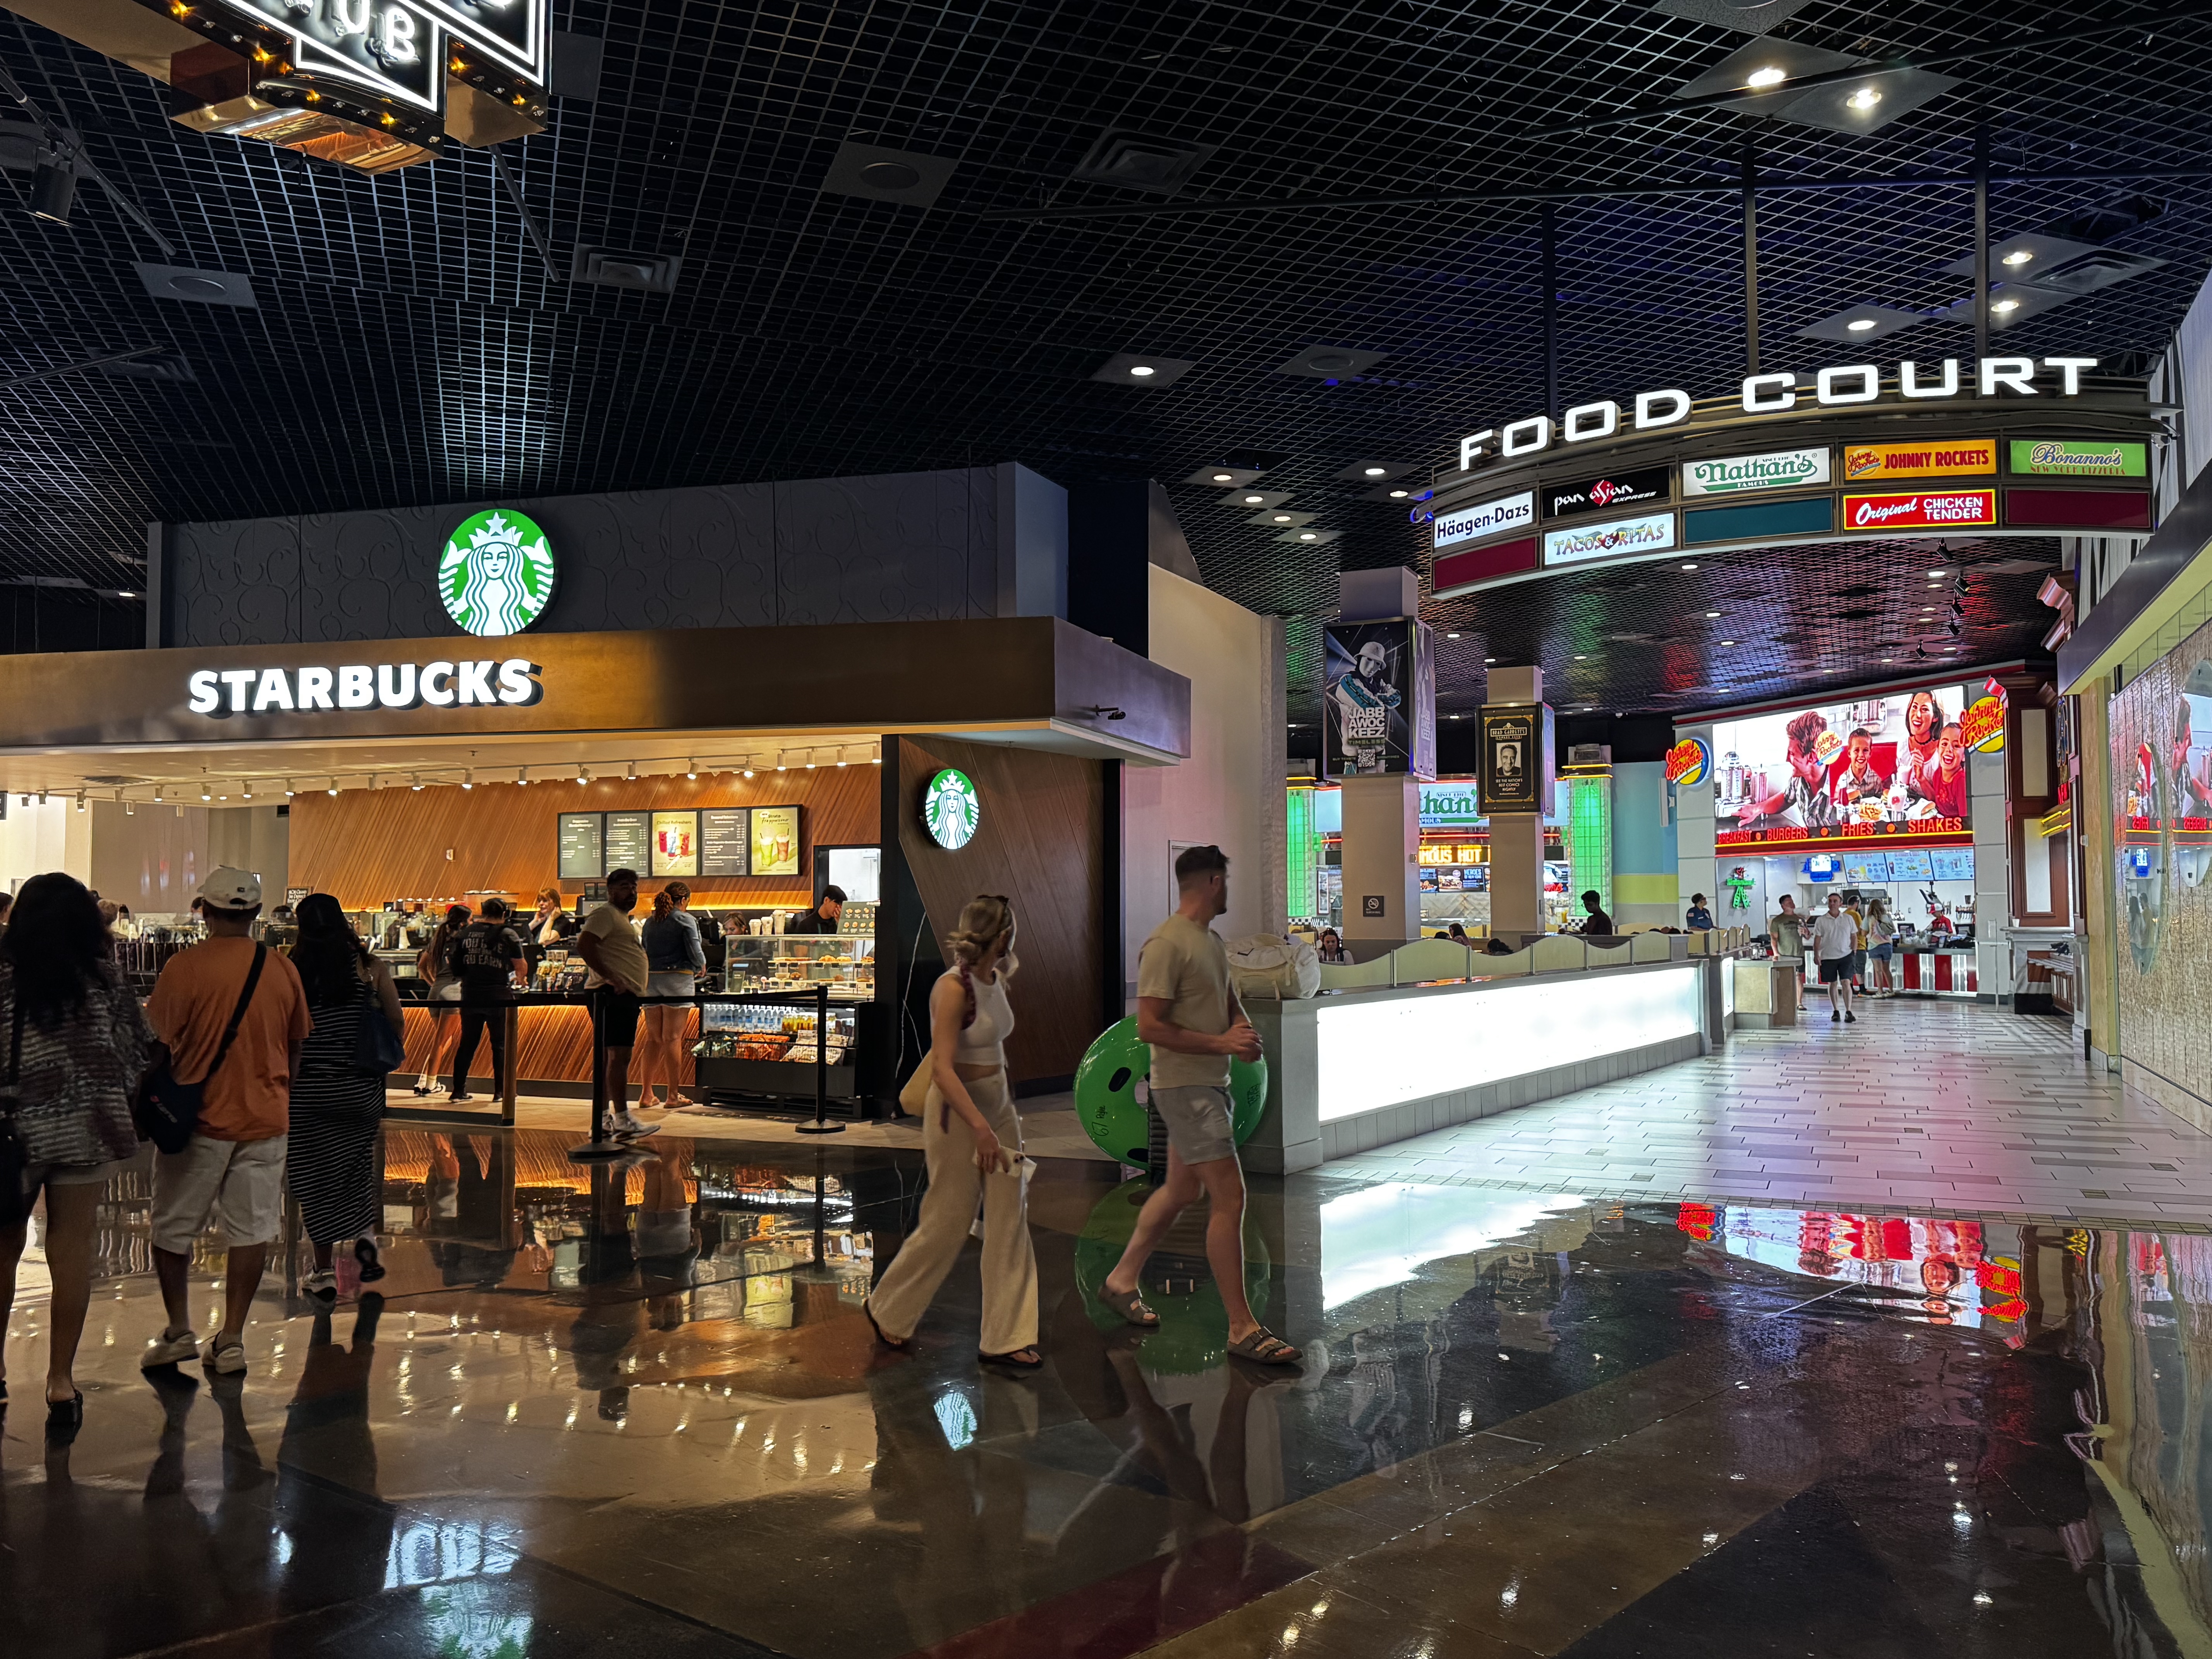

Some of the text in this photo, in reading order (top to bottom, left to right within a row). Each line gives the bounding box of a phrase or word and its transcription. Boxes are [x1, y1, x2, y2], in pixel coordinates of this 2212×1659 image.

[289, 0, 417, 60] UB
[1461, 357, 2097, 471] FOOD COURT
[1848, 451, 1874, 472] Johnny
[1884, 449, 1989, 469] JOHNNY ROCKETS
[2031, 442, 2122, 466] Bonanno's
[1695, 453, 1818, 483] Nathan's
[2054, 466, 2077, 474] YORK
[1737, 479, 1769, 488] FAMOUS
[1554, 493, 1585, 516] pan
[1855, 497, 1917, 525] Original
[1923, 496, 1983, 509] CHICKEN
[1923, 508, 1982, 520] TENDER
[1437, 504, 1529, 539] Häagen-Dazs
[1554, 534, 1602, 555] TACOS
[189, 658, 536, 714] STARBUCKS
[1348, 707, 1385, 719] JABB
[1348, 717, 1385, 728] AWOC
[1958, 697, 2003, 747] Johnny
[1348, 726, 1385, 739] KEEZ
[1965, 716, 2003, 747] Rocke
[1666, 740, 1697, 780] Johnny
[1718, 817, 1963, 844] BREAKFAST BURGERS FRIES SHAKES
[1092, 1122, 1109, 1136] 67
